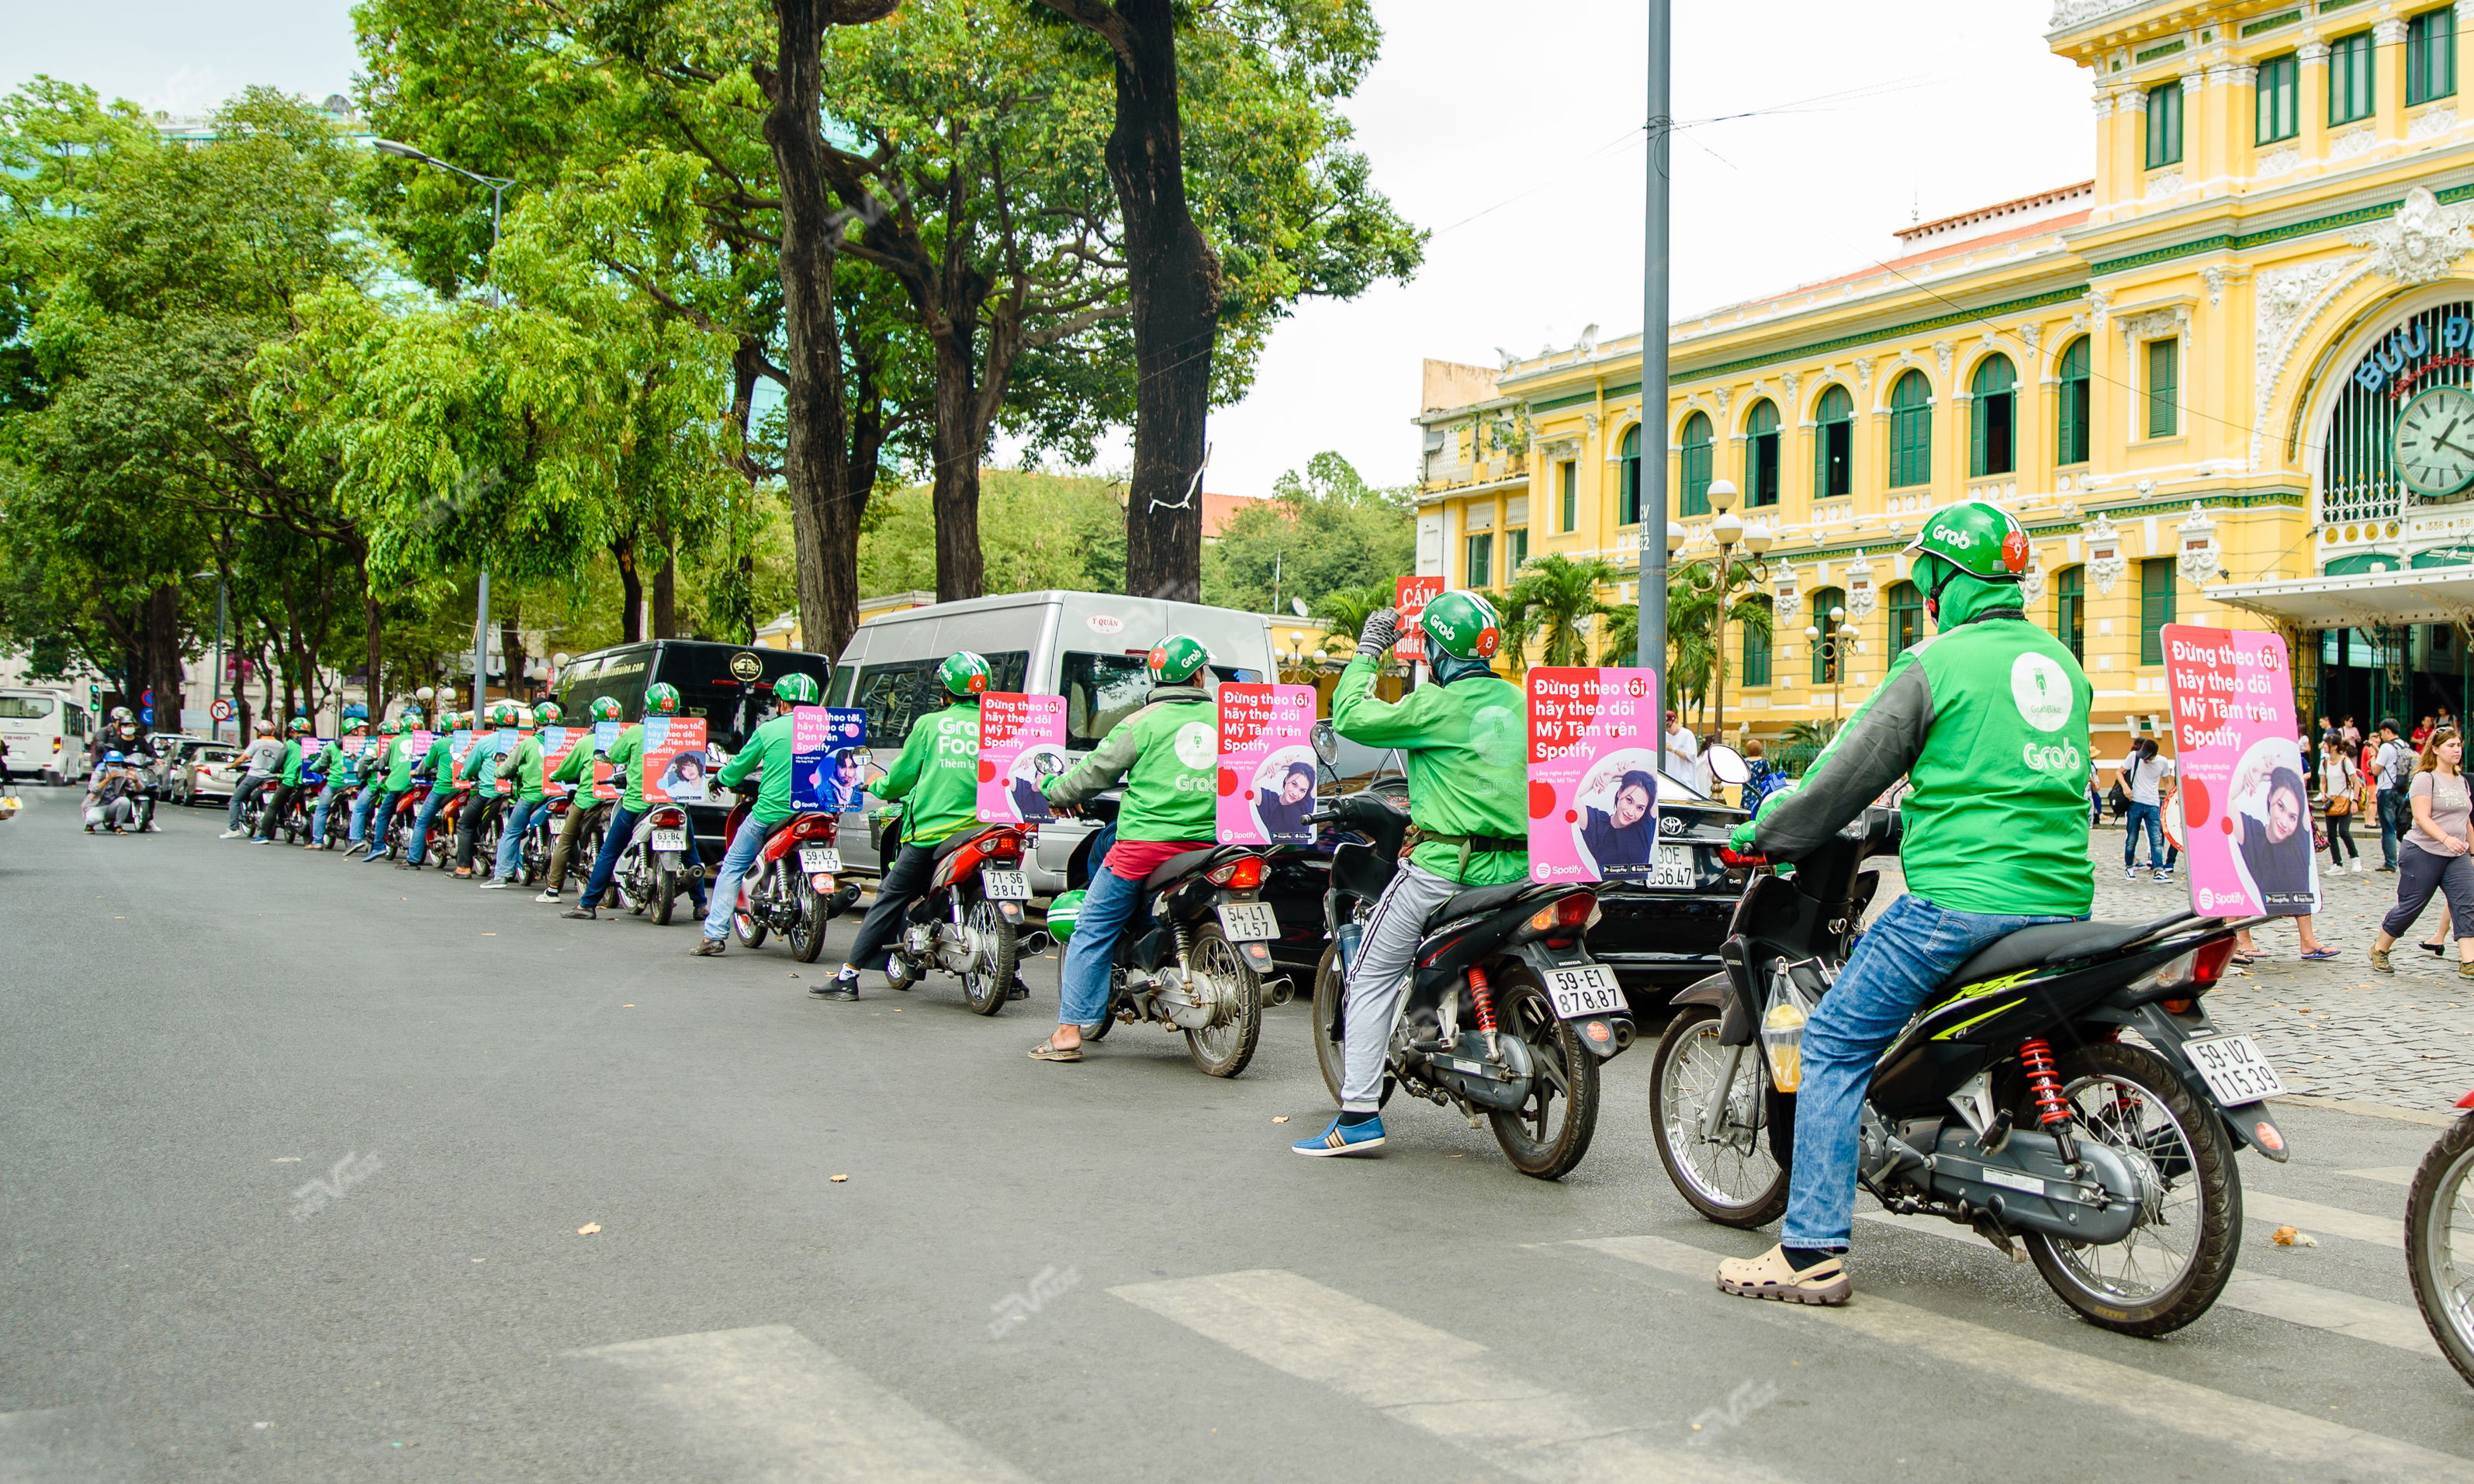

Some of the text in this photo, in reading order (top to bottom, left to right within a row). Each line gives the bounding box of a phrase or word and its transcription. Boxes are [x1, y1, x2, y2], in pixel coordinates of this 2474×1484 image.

[2420, 353, 2441, 375] PHỐ
[2445, 351, 2461, 365] HỒ
[1932, 524, 1971, 549] Grab
[2013, 543, 2022, 560] 9
[1403, 579, 1437, 607] CẤM
[1431, 614, 1455, 641] Grab
[1396, 635, 1419, 654] BUÔN
[1486, 636, 1493, 649] 8
[1154, 653, 1161, 663] 7
[1181, 649, 1202, 669] Grab
[2172, 640, 2282, 673] Đừng theo tôi,
[975, 680, 981, 688] 6
[1535, 679, 1649, 698] Đừng theo tôi,
[2175, 668, 2272, 694] hãy theo dõi
[985, 699, 1062, 714] Đừng theo tôi,
[1223, 691, 1311, 708] Đừng theo tôi,
[1224, 707, 1299, 721] hãy theo dõi
[1536, 700, 1635, 719] hãy theo dõi
[2031, 704, 2061, 714] GrabBike
[2180, 697, 2278, 722] Mỹ Tâm trên
[798, 712, 862, 724] Đừng theo tôi,
[985, 711, 1051, 725] hãy theo dõi
[798, 722, 814, 732] hãy
[839, 723, 853, 732] dõi
[985, 724, 1053, 737] Mỹ Tâm trên
[1224, 723, 1301, 738] Mỹ Tâm trên
[1536, 721, 1637, 740] Mỹ Tâm trên
[797, 732, 838, 742] Đen trên
[984, 737, 1024, 749] Spotify
[2183, 724, 2241, 751] Spotify
[797, 742, 830, 752] Spotify
[1223, 739, 1270, 754] Spotify
[1536, 741, 1597, 761] Spotify
[2023, 737, 2080, 770] Grab
[970, 759, 976, 770] là
[2200, 763, 2213, 772] nghe
[2213, 763, 2230, 772] playlist
[1536, 770, 1548, 778] Lắng
[806, 850, 833, 860] 59-L2
[1552, 864, 1582, 876] Spotify
[991, 873, 1022, 884] 71-S6
[993, 885, 1024, 896] 3847
[2214, 892, 2245, 906] Spotify
[1227, 906, 1265, 922] 54-L1
[1233, 922, 1268, 938] 1457
[1555, 969, 1605, 991] 59-E1
[2189, 1029, 2213, 1038] HONDA
[2211, 1066, 2278, 1100] 115.39
